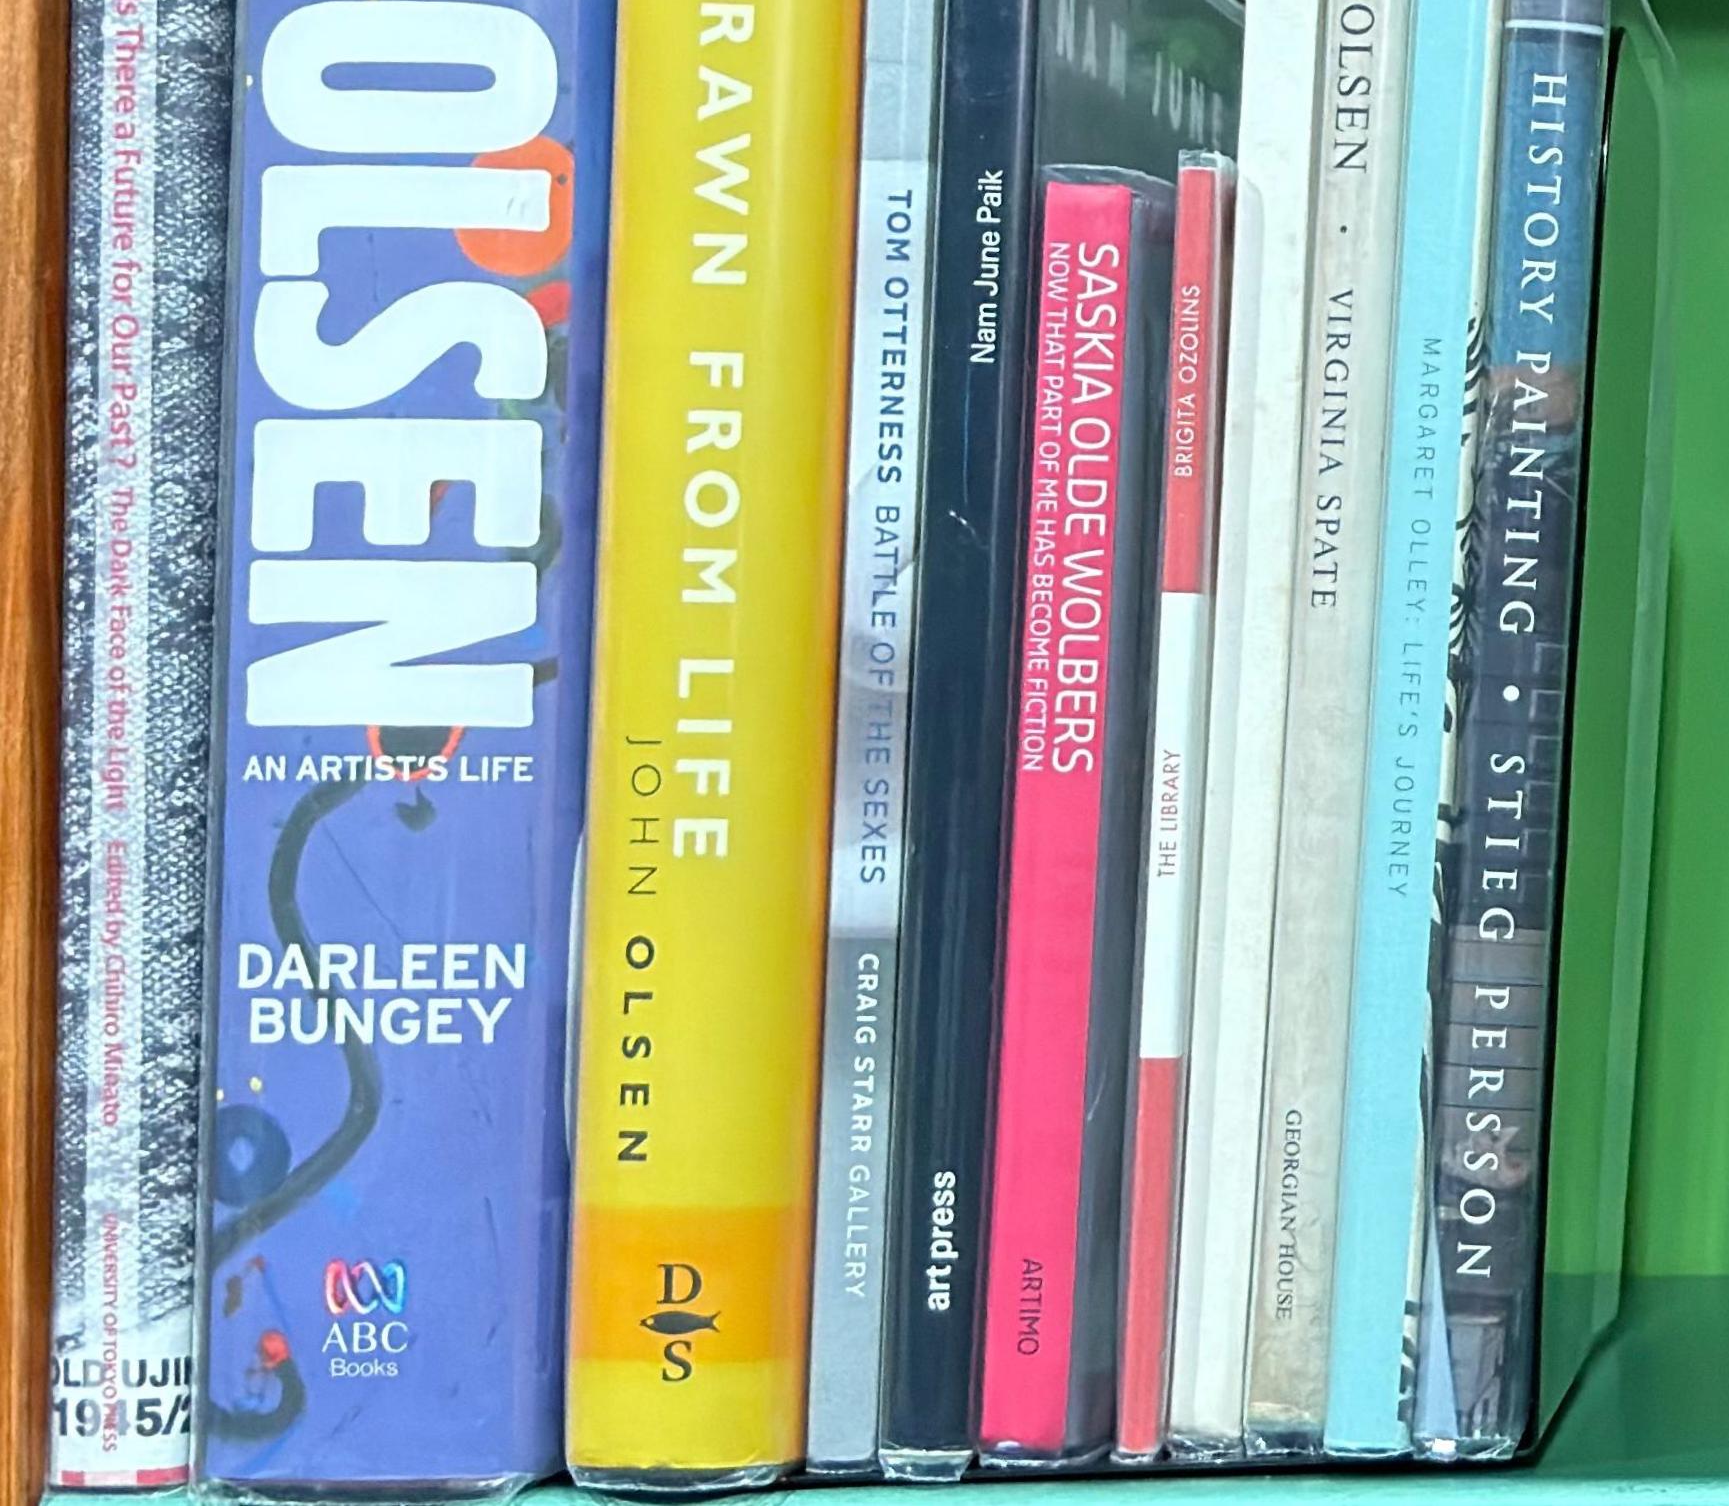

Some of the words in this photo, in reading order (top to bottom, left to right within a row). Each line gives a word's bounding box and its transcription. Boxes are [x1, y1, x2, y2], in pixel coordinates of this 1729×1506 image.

[114, 24, 145, 114] There
[1333, 2, 1376, 174] OLSEN
[114, 122, 135, 140] a
[112, 149, 142, 251] Future
[885, 188, 912, 262] TOM
[976, 168, 1004, 223] Paik
[1519, 72, 1567, 325] HISTORY
[111, 259, 143, 306] for
[973, 230, 1000, 296] June
[1047, 242, 1070, 303] NOW
[110, 314, 139, 375] Our
[244, 0, 559, 727] OLSEN
[970, 304, 997, 364] Nam
[1044, 309, 1068, 370] THAT
[1071, 242, 1121, 405] SASKIA
[1178, 284, 1201, 384] OZOLINS
[874, 273, 910, 485] OTTERNESS
[1040, 375, 1064, 436] PART
[1318, 289, 1354, 476] VIRGINIA
[1413, 338, 1443, 499] MARGARET
[1038, 441, 1061, 473] OF
[1064, 417, 1111, 536] OLDE
[1172, 392, 1195, 478] BRIGITA
[110, 487, 134, 533] The
[681, 351, 745, 606] FROM
[1036, 479, 1059, 512] ME
[1499, 350, 1551, 635] PAINTING
[109, 540, 132, 596] Dark
[869, 505, 902, 628] BATTLE
[1032, 519, 1057, 567] HAS
[1311, 494, 1342, 608] SPATE
[1404, 519, 1432, 622] OLLEY:
[107, 605, 132, 661] Face
[869, 642, 895, 687] OF
[1027, 573, 1054, 673] BECOME
[1051, 549, 1105, 774] WOLBERS
[106, 666, 131, 697] of
[106, 700, 129, 741] the
[1398, 642, 1423, 738] LIFE'S
[673, 657, 735, 859] LIFE
[865, 699, 893, 765] THE
[1022, 680, 1049, 772] FICTION
[101, 745, 129, 812] Light
[242, 755, 292, 783] AN
[296, 755, 450, 783] ARTIST'S
[459, 755, 535, 783] LIFE
[1159, 749, 1181, 834] LIBRARY
[625, 736, 662, 896] JOHN
[860, 779, 889, 884] SEXES
[1388, 756, 1415, 898] JOURNEY
[1479, 753, 1526, 942] STIEG
[104, 840, 126, 914] Edited
[1156, 840, 1177, 878] THE
[100, 919, 124, 946] by
[238, 942, 527, 991] DARLEEN
[249, 997, 513, 1045] BUNGEY
[853, 952, 881, 1046] CRAIG
[616, 936, 656, 1164] OLSEN
[848, 1054, 876, 1155] STARR
[1456, 985, 1511, 1278] PERSSON
[1280, 1109, 1302, 1232] GEORGIAN
[843, 1164, 871, 1298] GALLERY
[930, 1170, 959, 1260] press
[102, 1212, 118, 1313] UNIVERSITY
[657, 1264, 702, 1304] D
[927, 1264, 951, 1311] art
[1275, 1243, 1295, 1321] HOUSE
[102, 1313, 117, 1338] OF
[322, 1322, 409, 1353] ABC
[1017, 1258, 1043, 1356] ARTIMO
[102, 1341, 117, 1399] TOKYO
[330, 1358, 399, 1377] Books
[662, 1341, 693, 1383] S
